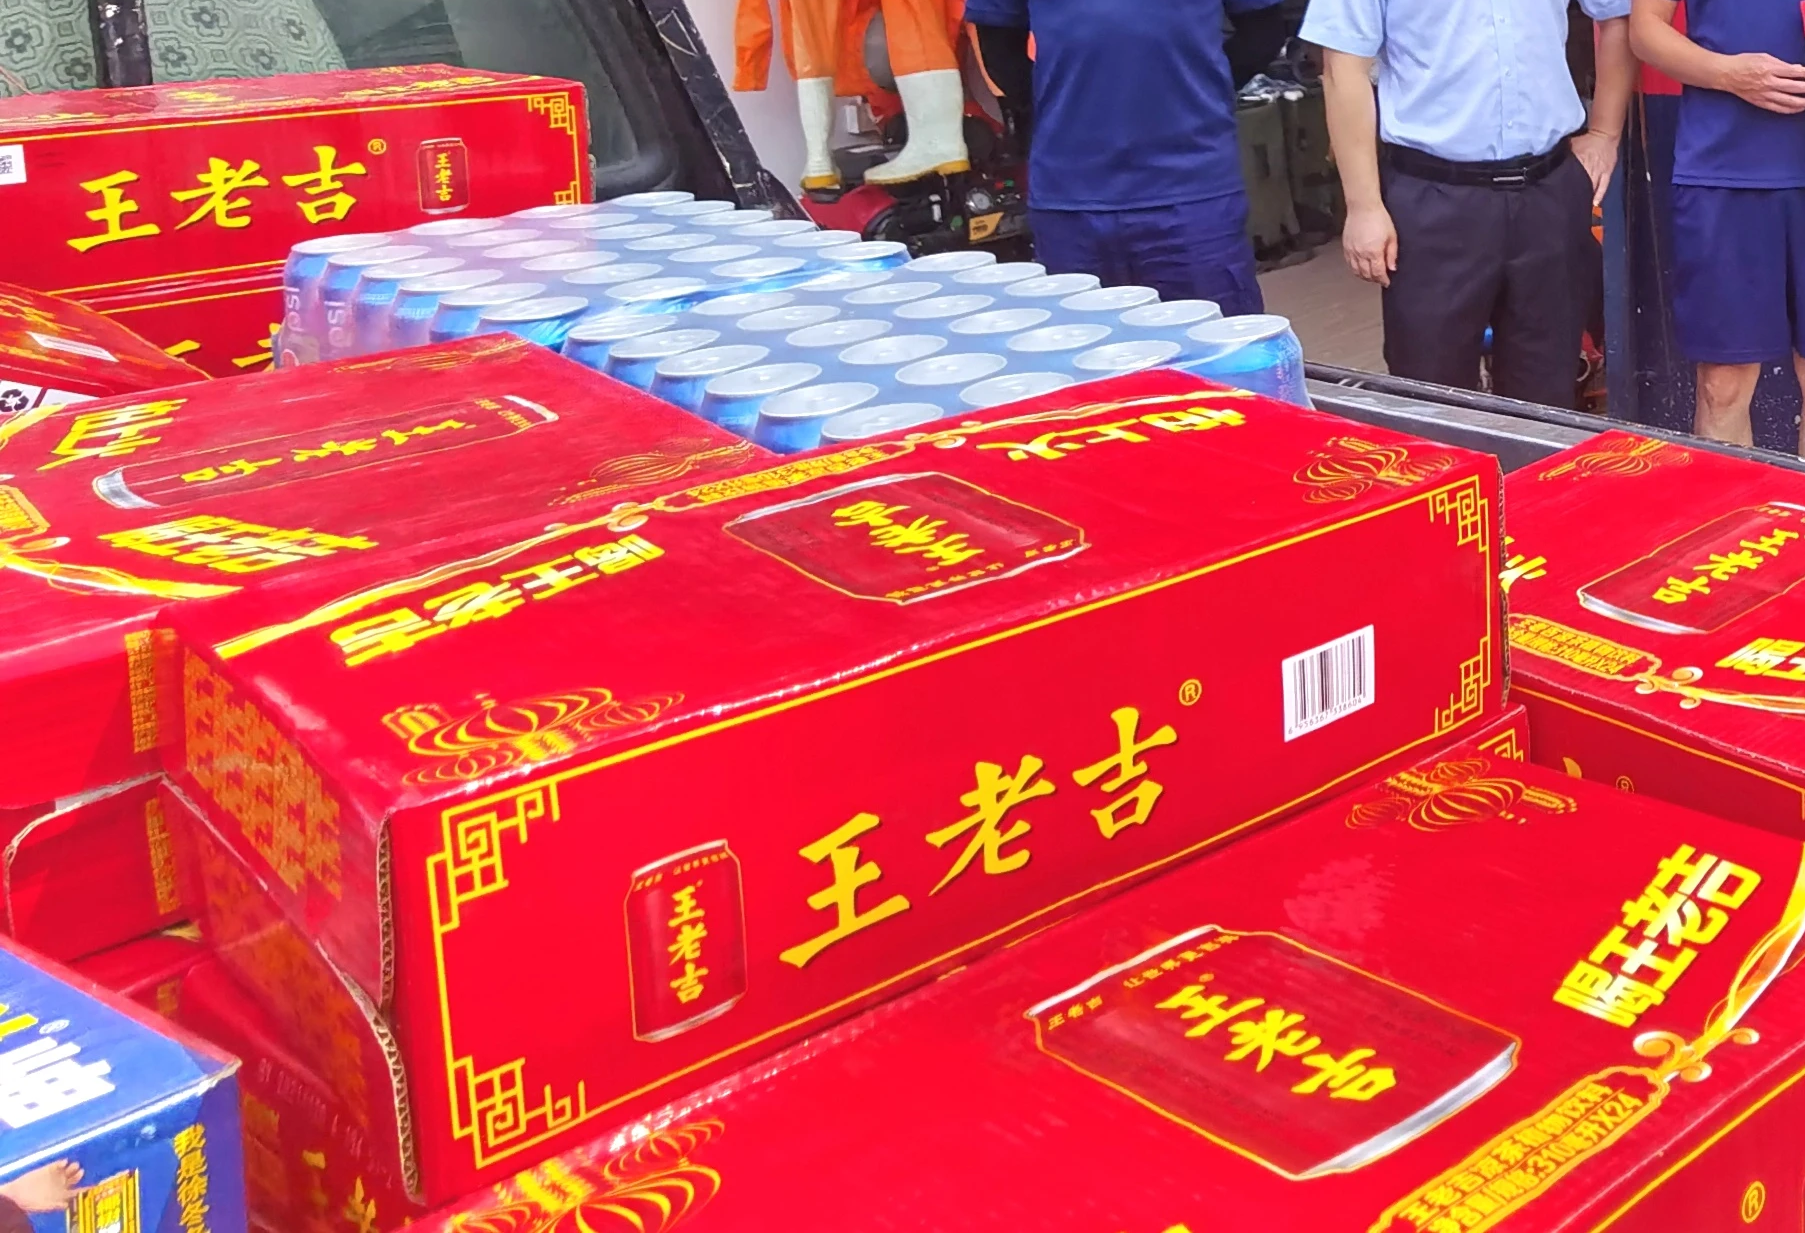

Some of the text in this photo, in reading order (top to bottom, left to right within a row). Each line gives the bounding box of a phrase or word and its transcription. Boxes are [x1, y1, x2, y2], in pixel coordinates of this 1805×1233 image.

[67, 145, 367, 253] 王老吉
[433, 149, 452, 202] 王老吉
[977, 406, 1248, 462] 怕上火
[831, 499, 986, 567] 王老吉
[1652, 528, 1801, 604] 王老吉
[329, 533, 666, 668] 喝王老吉
[780, 706, 1179, 969] 王老吉
[667, 884, 710, 1003] 王老吉
[1552, 843, 1763, 1029] 喝王老吉
[1155, 984, 1397, 1102] 王老吉
[1398, 1081, 1613, 1225] 王老吉凉茶植物饮料
